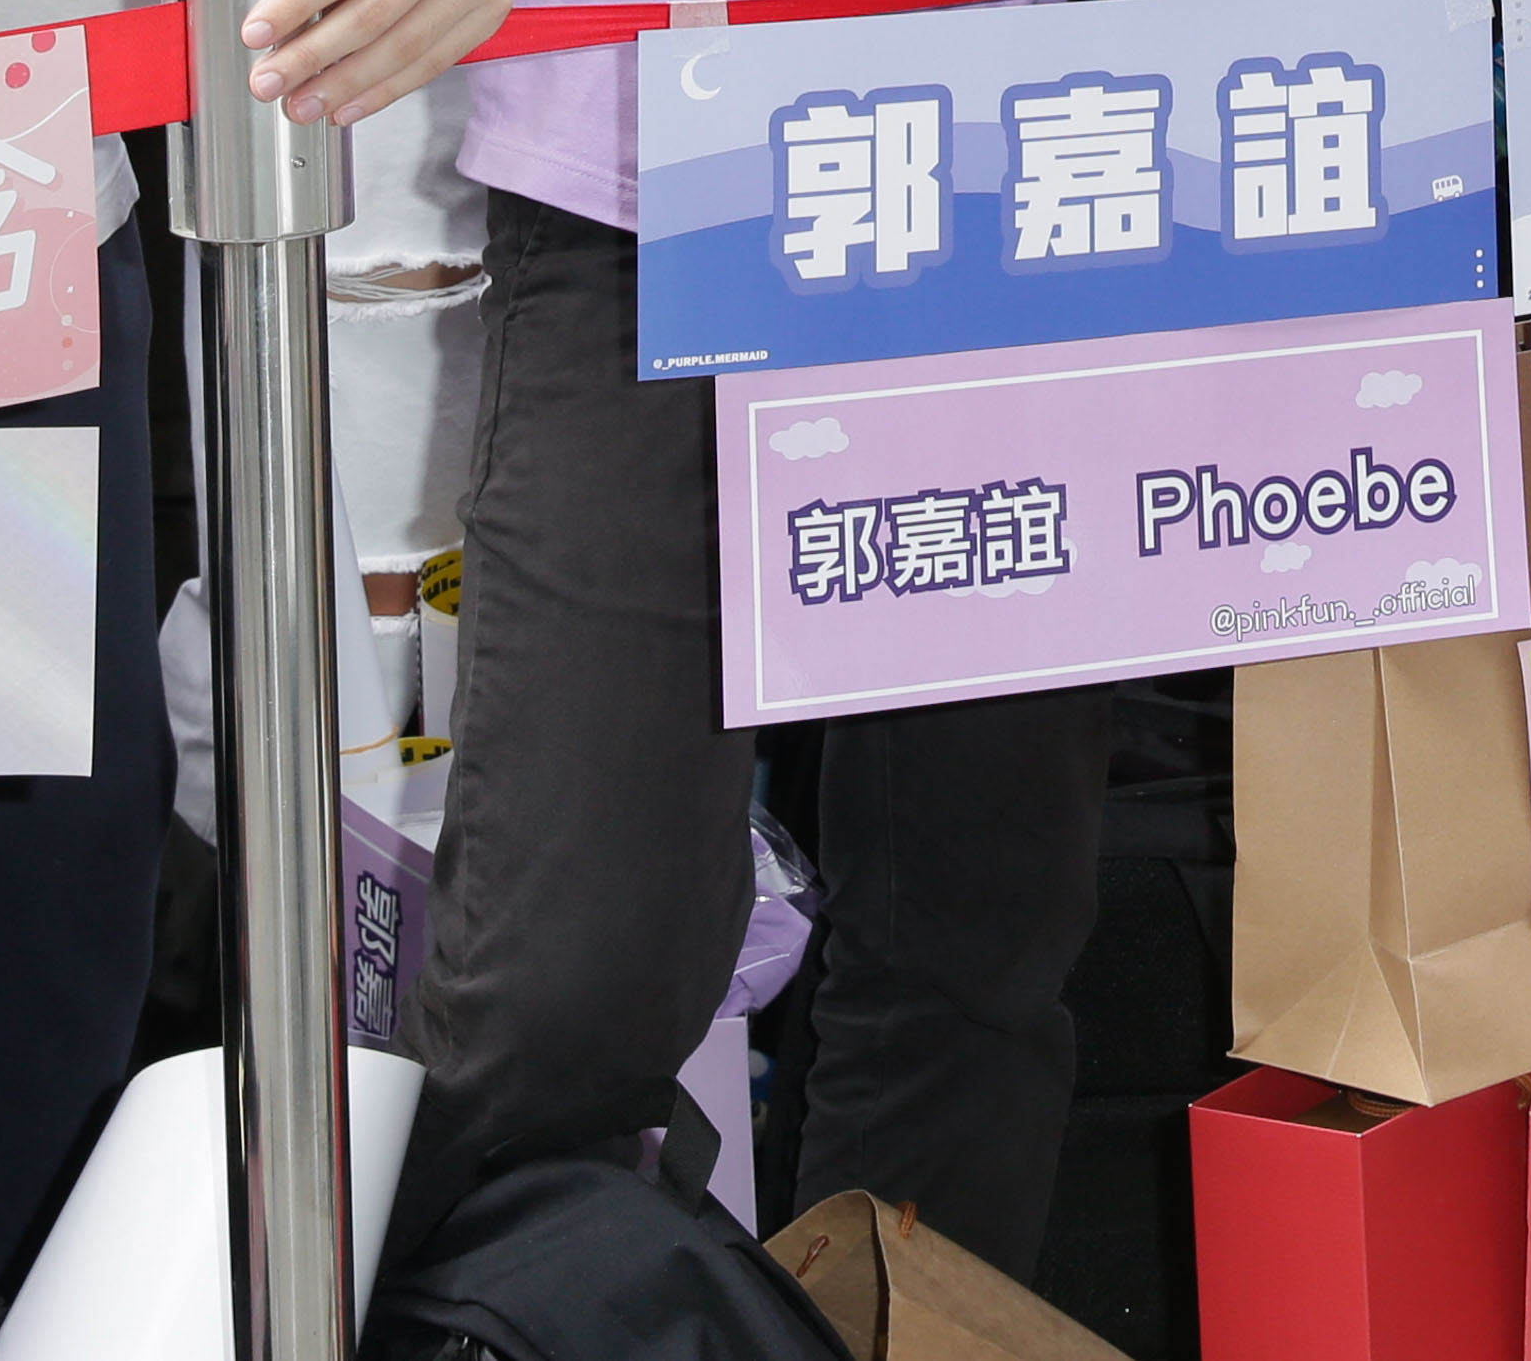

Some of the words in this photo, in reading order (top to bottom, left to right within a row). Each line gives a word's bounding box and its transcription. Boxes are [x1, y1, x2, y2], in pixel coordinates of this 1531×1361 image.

[781, 65, 1377, 280] 郭嘉誼
[653, 349, 769, 371] @_PURPLE.MERMAID
[793, 483, 1066, 599] 郭嘉誼
[1140, 454, 1449, 554] Phoebe
[1209, 575, 1478, 641] @pinkfun._.official
